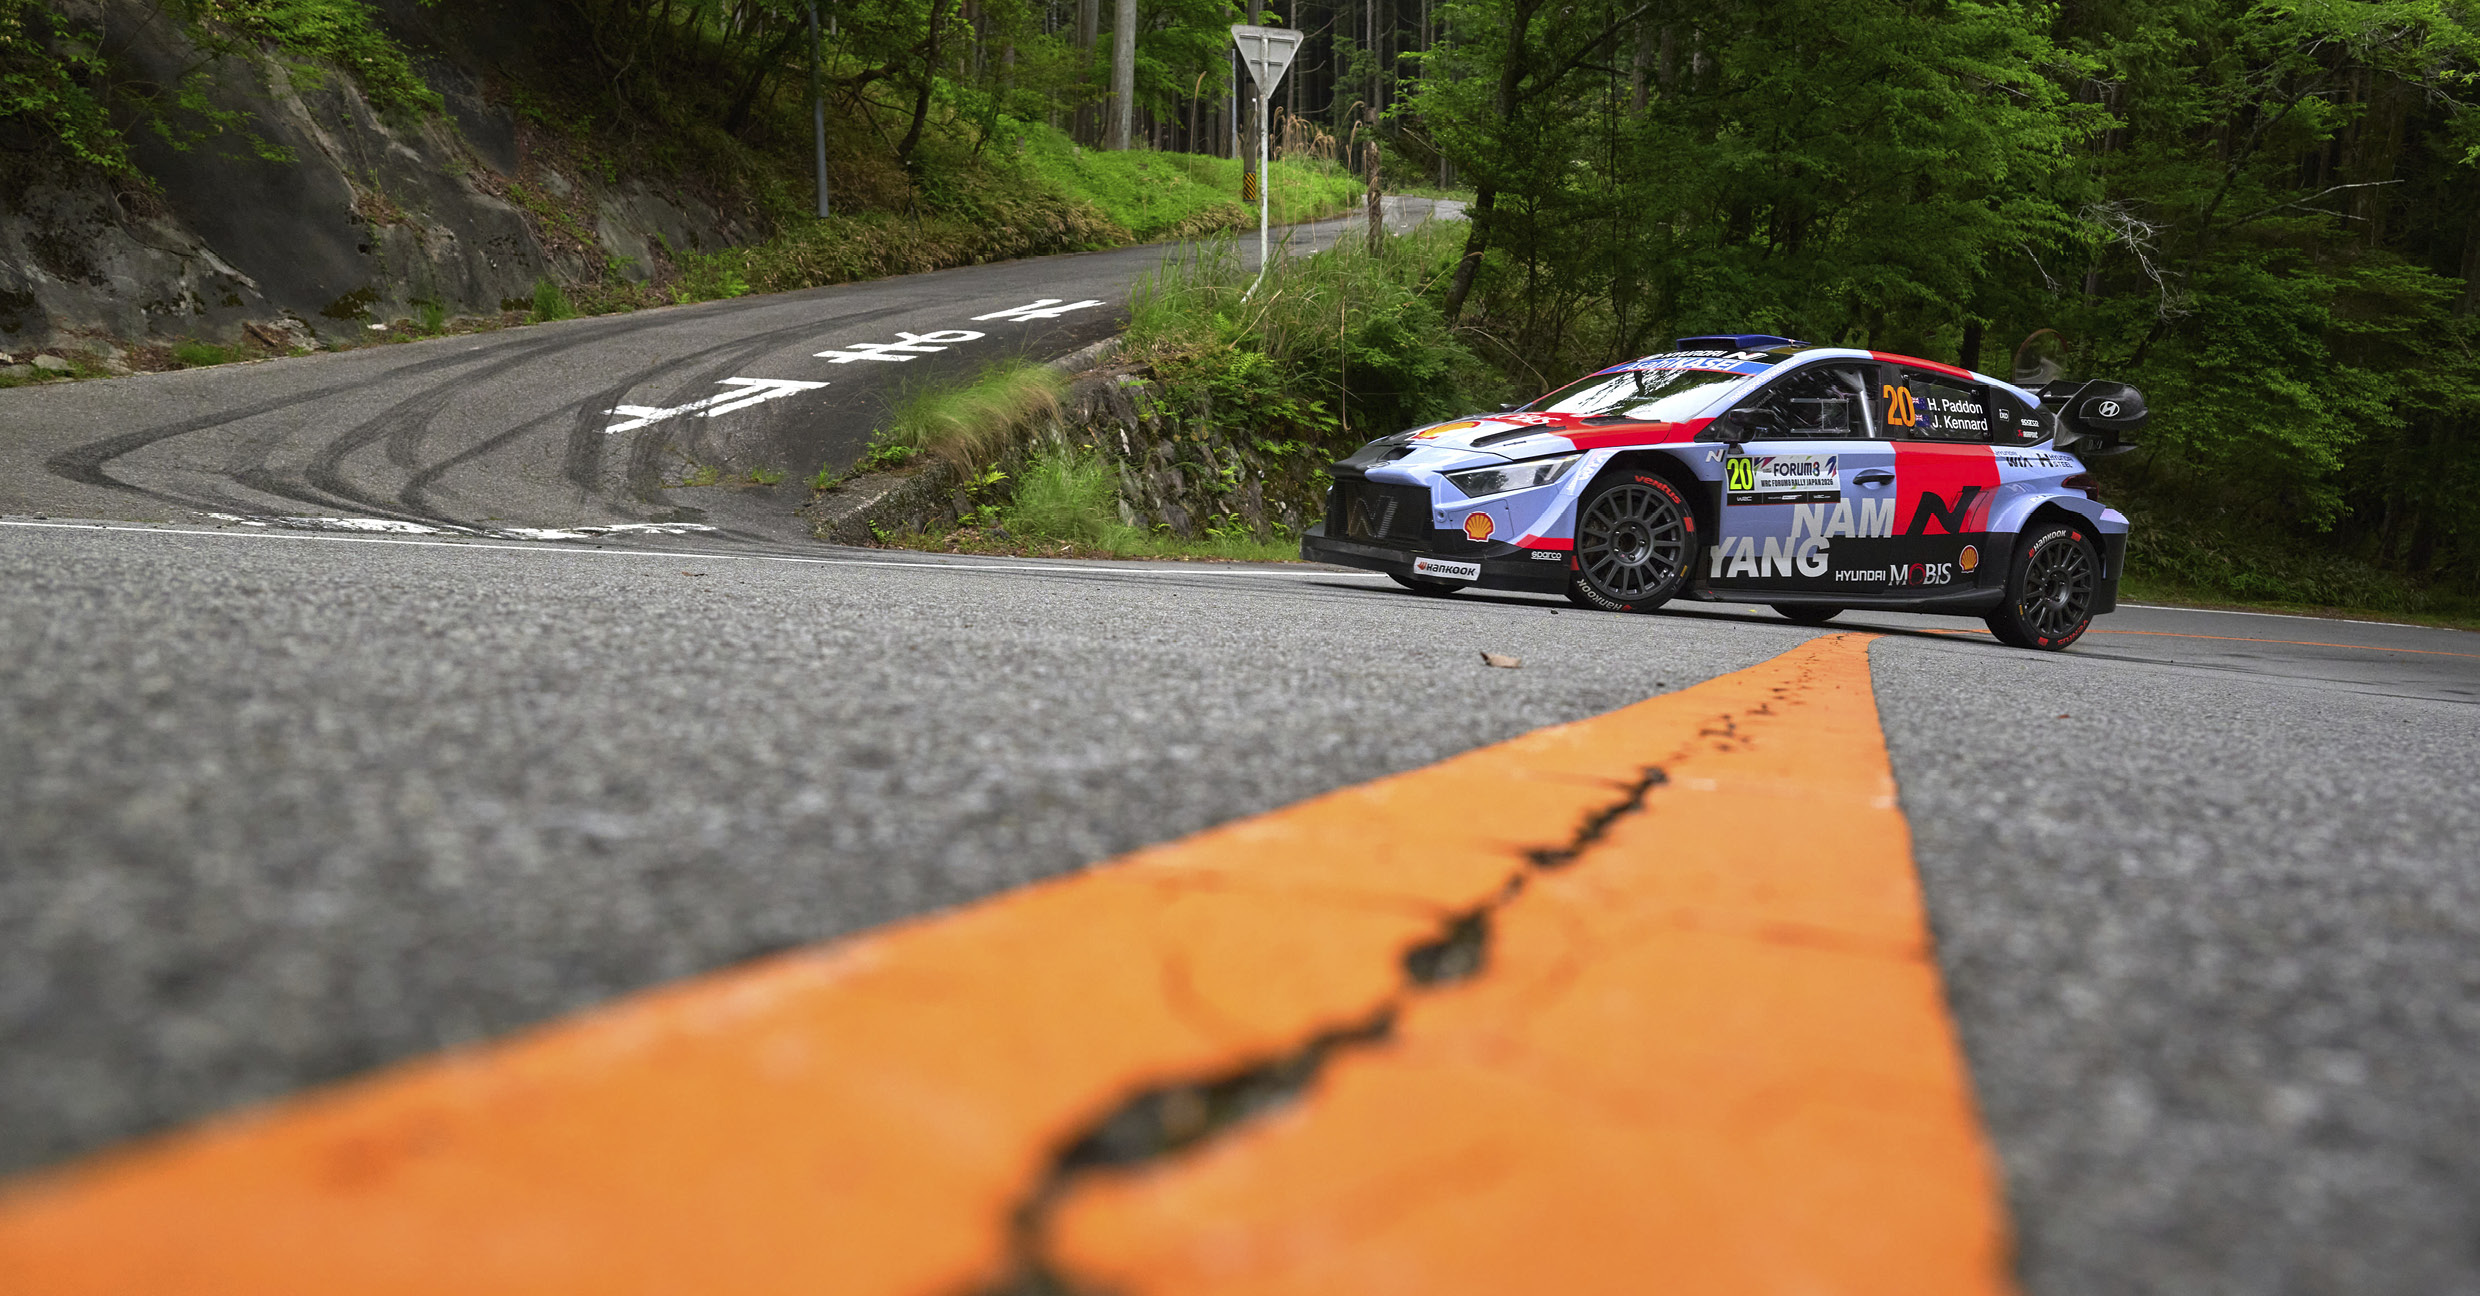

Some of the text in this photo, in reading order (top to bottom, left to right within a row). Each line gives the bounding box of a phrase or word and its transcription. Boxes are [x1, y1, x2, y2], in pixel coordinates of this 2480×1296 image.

[1883, 384, 1916, 427] 20
[1927, 398, 1983, 414] H. Paddon
[1932, 415, 1942, 428] J.
[1943, 415, 1988, 431] Kennard
[1705, 448, 1726, 463] N
[1727, 458, 1754, 490] 20
[1773, 461, 1820, 477] FORUM8
[1791, 497, 1896, 538] NAM
[1906, 486, 1982, 535] N
[1531, 550, 1562, 560] sparco
[1710, 536, 1830, 578] YANG
[1836, 562, 1952, 586] HYUNDAI MOBIS
